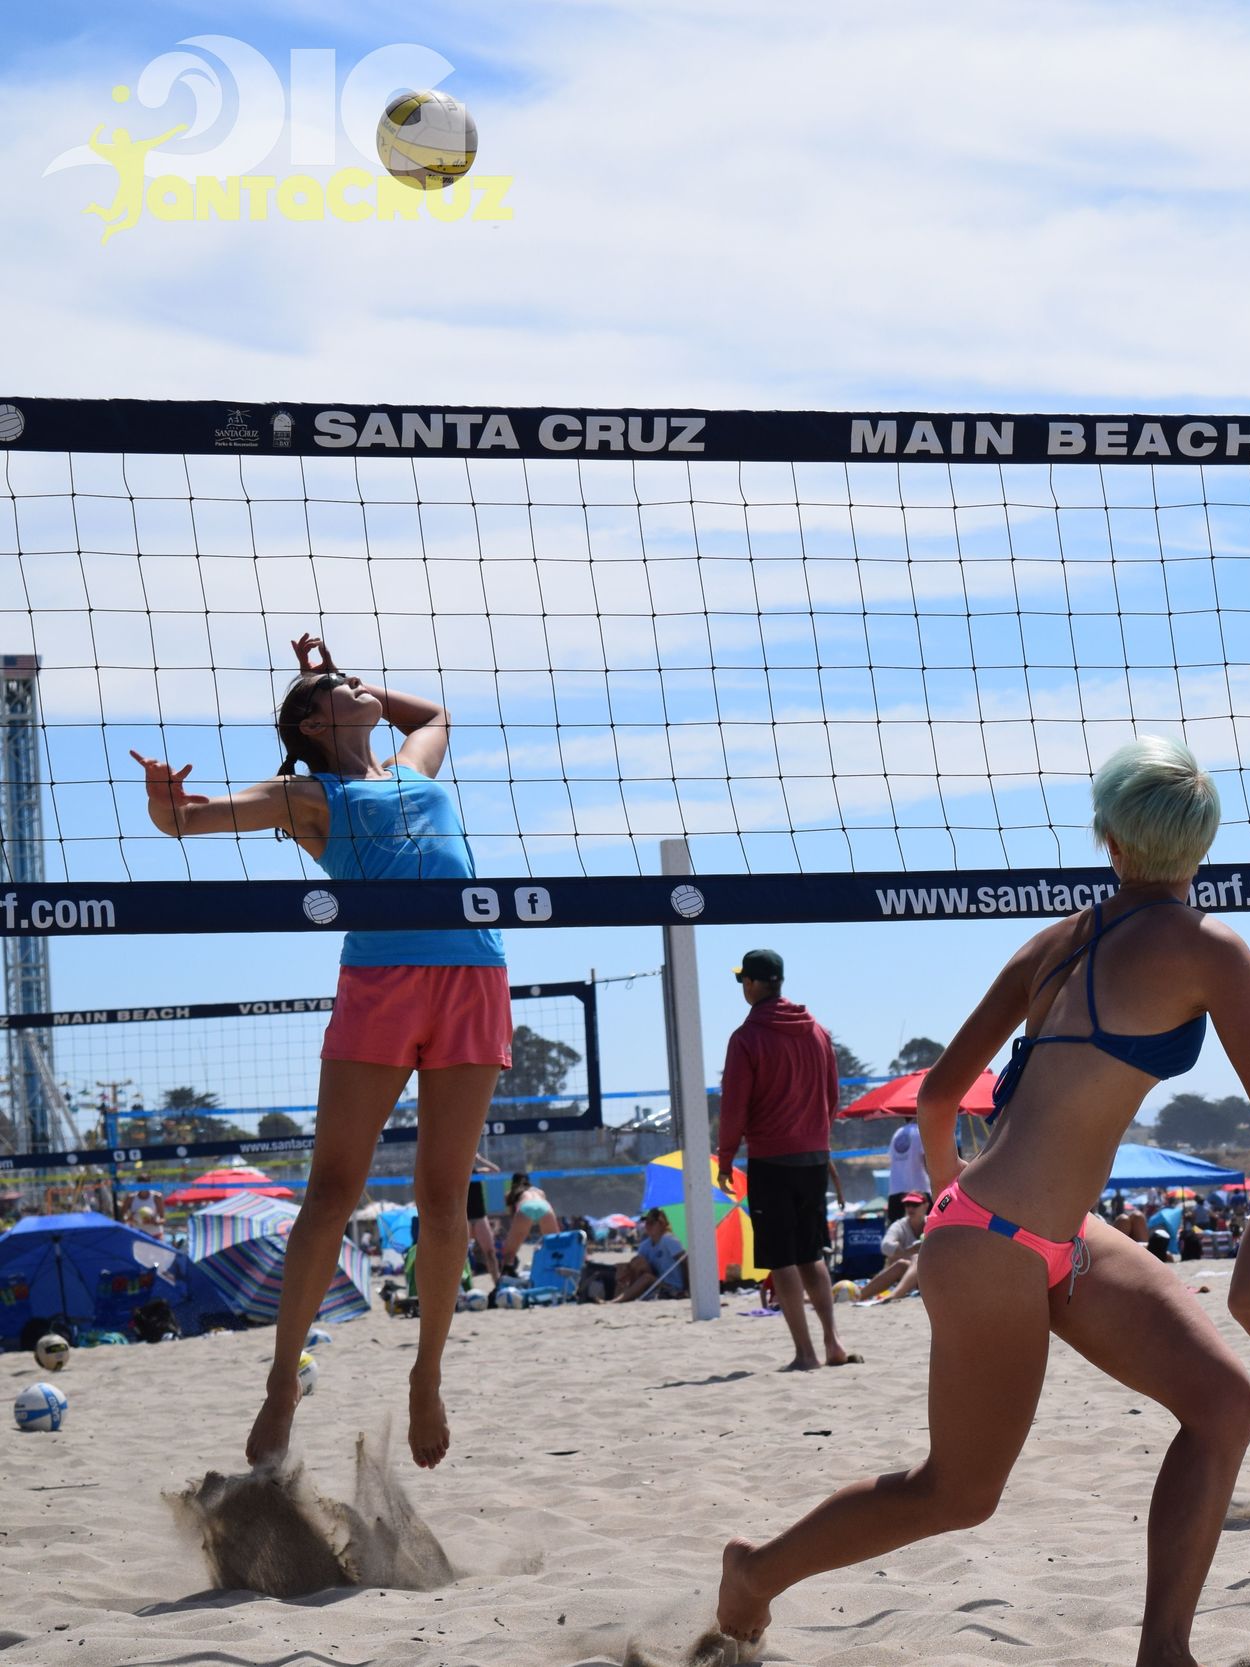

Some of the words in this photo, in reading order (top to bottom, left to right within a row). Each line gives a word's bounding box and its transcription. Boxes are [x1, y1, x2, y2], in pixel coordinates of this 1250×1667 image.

[313, 410, 520, 449] SANTA
[538, 415, 706, 452] CRUZ
[849, 420, 1014, 455] MAIN
[0, 892, 116, 929] f.com
[53, 1012, 108, 1026] MAIN
[117, 1007, 190, 1021] BEACH
[239, 1000, 334, 1015] VOLLEYB
